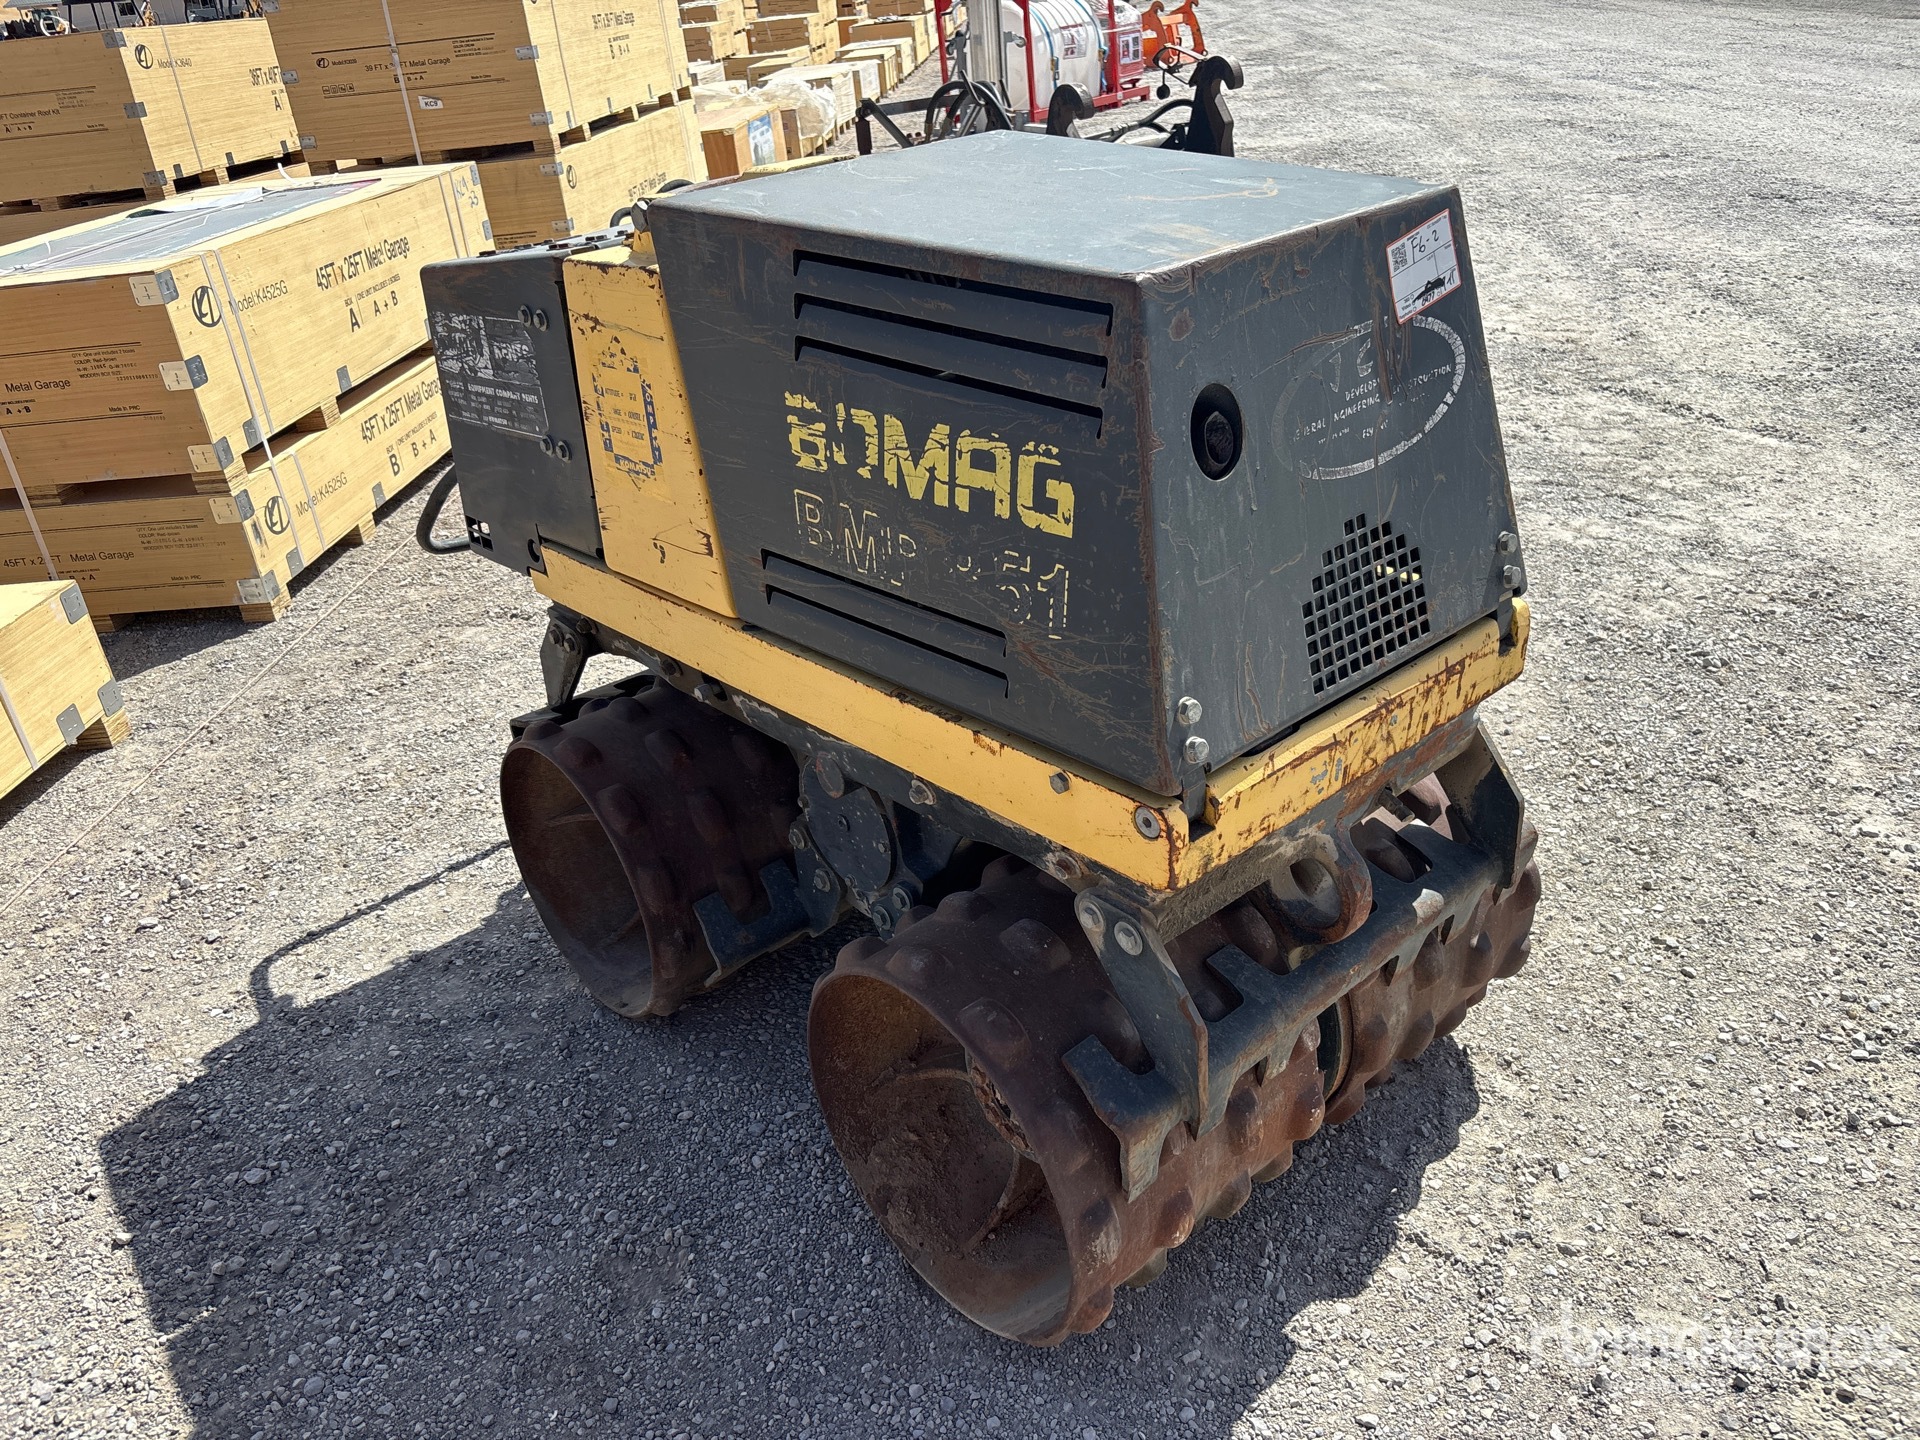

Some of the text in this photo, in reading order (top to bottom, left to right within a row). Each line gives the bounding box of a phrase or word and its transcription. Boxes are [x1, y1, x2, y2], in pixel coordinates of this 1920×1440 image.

[364, 64, 373, 72] 39
[374, 63, 383, 71] FT
[409, 59, 427, 68] Metal
[427, 57, 451, 66] Garage
[9, 111, 37, 120] Container
[274, 96, 283, 111] A
[315, 236, 410, 292] 45FT x 25FT Metal Garage
[373, 299, 382, 317] A
[391, 290, 399, 307] B
[350, 307, 361, 333] A
[5, 380, 72, 393] Metal Garage
[6, 407, 13, 415] A
[24, 405, 32, 413] B
[360, 413, 380, 444] 45FT
[380, 414, 389, 432] x
[385, 398, 406, 428] 25FT
[405, 388, 424, 414] Metal
[1333, 393, 1381, 422] NGINEERING
[411, 441, 420, 458] B
[429, 429, 437, 445] A
[389, 453, 401, 477] B
[784, 390, 1077, 540] BOMAG
[3, 557, 27, 569] 45FT
[70, 551, 97, 563] Metal
[98, 550, 135, 563] Garage
[89, 573, 96, 581] A
